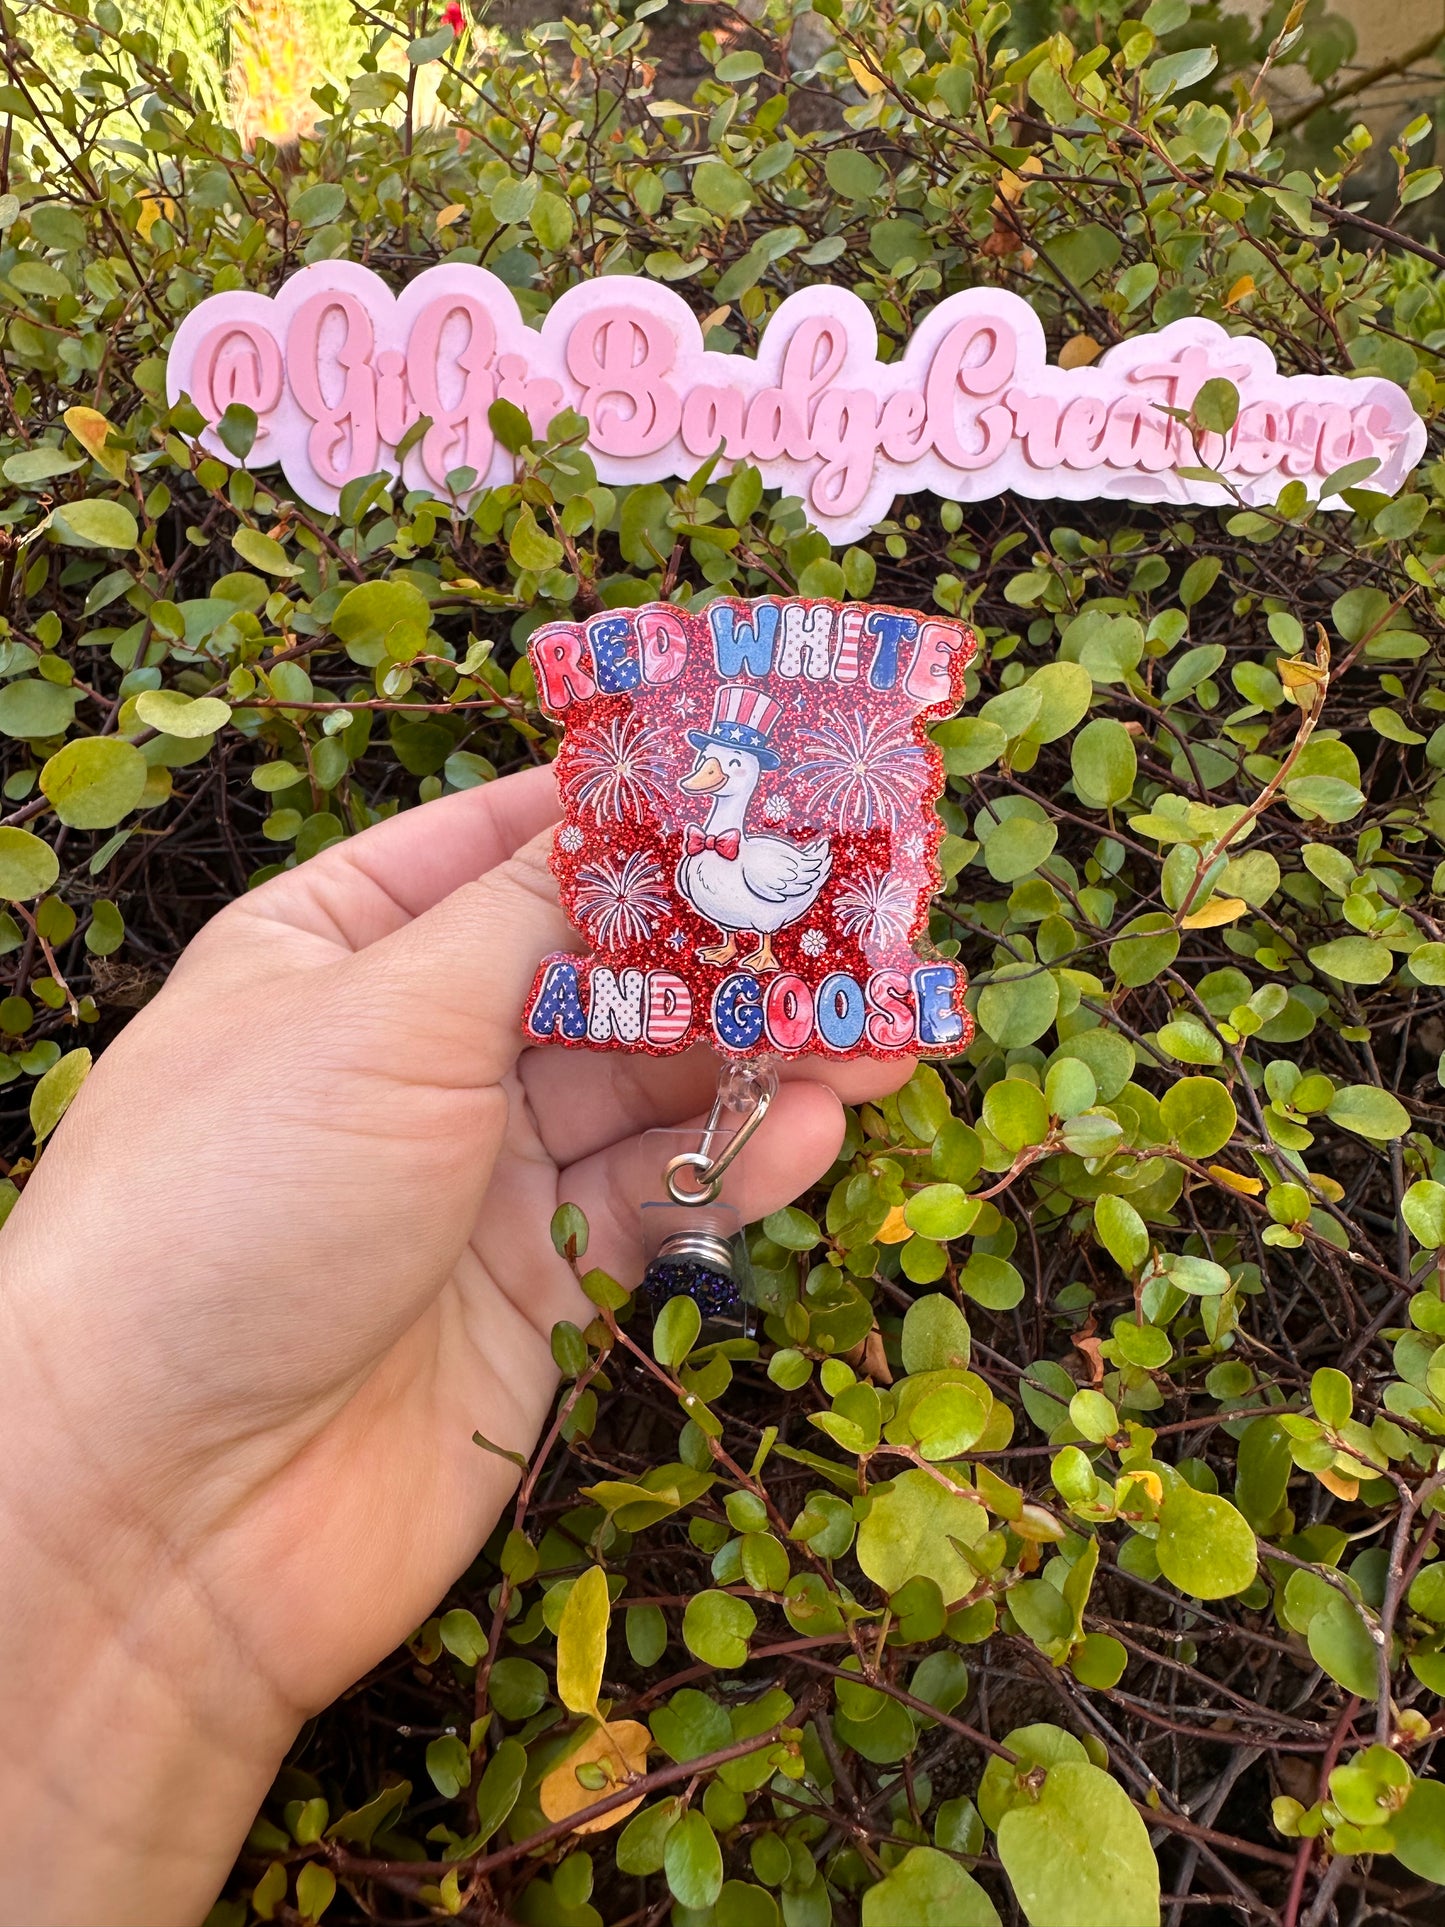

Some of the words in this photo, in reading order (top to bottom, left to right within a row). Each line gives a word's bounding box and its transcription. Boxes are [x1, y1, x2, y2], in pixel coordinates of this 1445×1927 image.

[534, 611, 690, 709] RED
[708, 604, 964, 702] WHITE
[531, 962, 693, 1045] AND
[712, 967, 966, 1051] GOOSE
